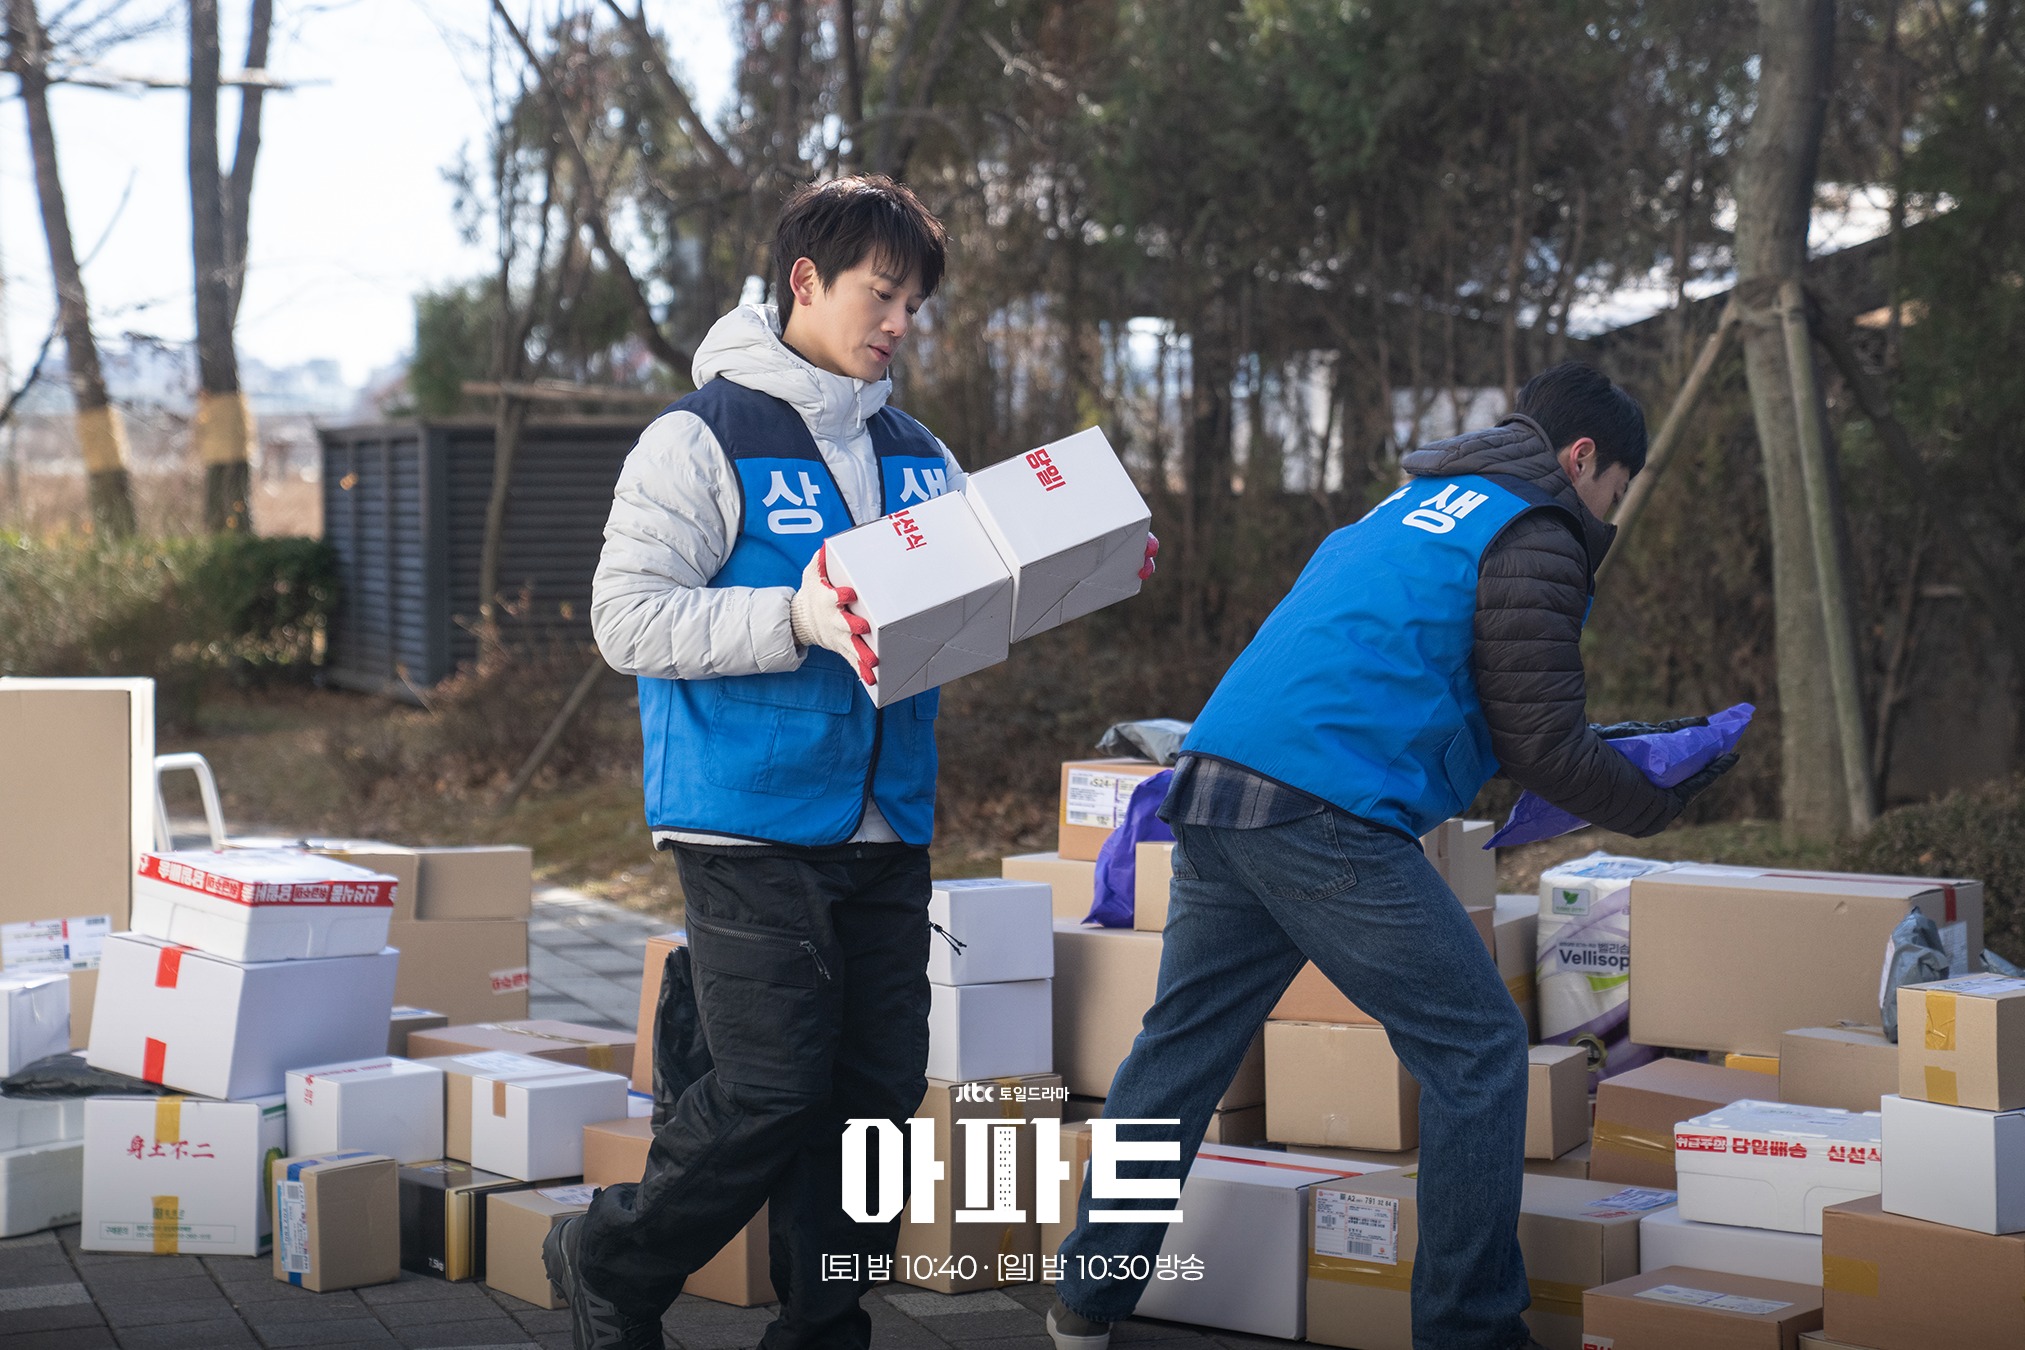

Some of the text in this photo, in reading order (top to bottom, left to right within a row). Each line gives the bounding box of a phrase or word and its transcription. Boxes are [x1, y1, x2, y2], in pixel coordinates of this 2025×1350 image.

[1026, 449, 1066, 492] 당일
[762, 470, 824, 535] 상
[1359, 483, 1489, 534] 생
[157, 859, 205, 889] 당일배송
[331, 884, 379, 903] 신선식품
[1559, 949, 1630, 972] Vellisop
[127, 1135, 215, 1160] 身土不二
[1732, 1138, 1807, 1158] 당일배송
